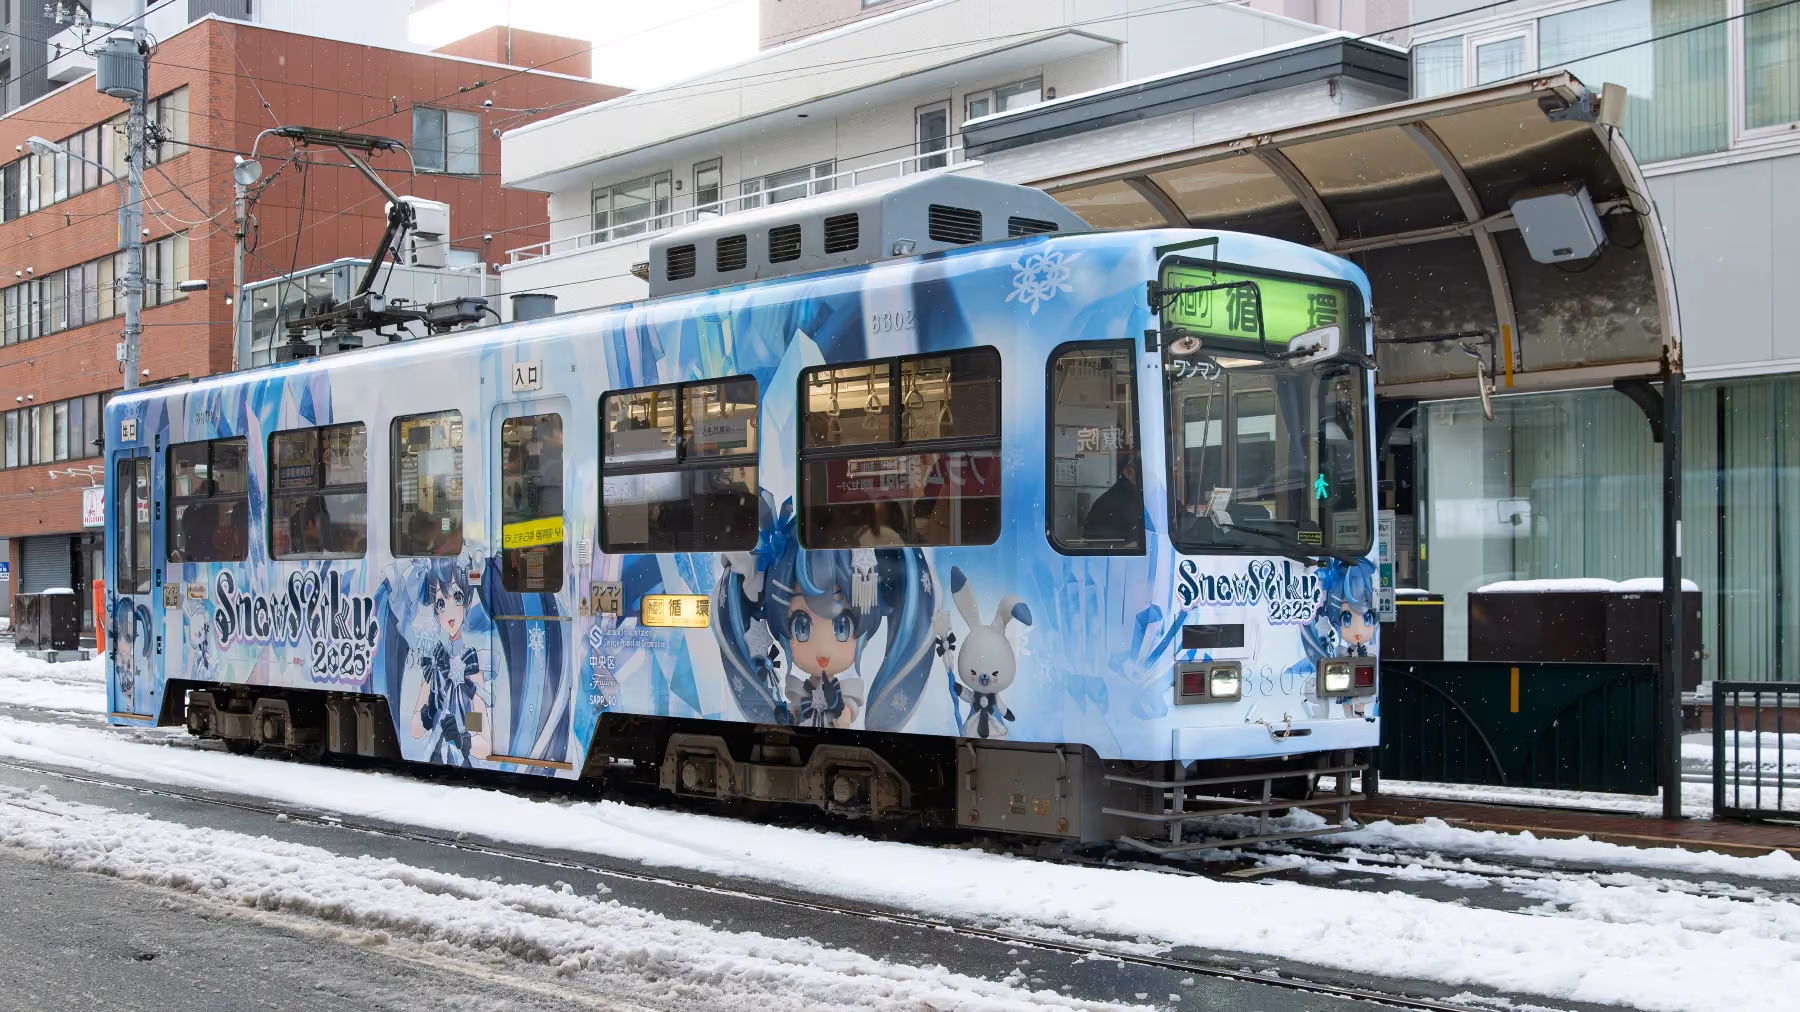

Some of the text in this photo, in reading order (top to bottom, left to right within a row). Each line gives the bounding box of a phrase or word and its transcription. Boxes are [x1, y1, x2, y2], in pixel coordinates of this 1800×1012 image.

[515, 366, 537, 386] 入口
[1173, 359, 1221, 380] ワンマン
[592, 585, 621, 597] ワンマン
[595, 598, 618, 613] 入口
[668, 598, 710, 617] 循環
[1270, 600, 1312, 620] 2025
[313, 641, 370, 676] 2025
[589, 655, 615, 669] 中央区
